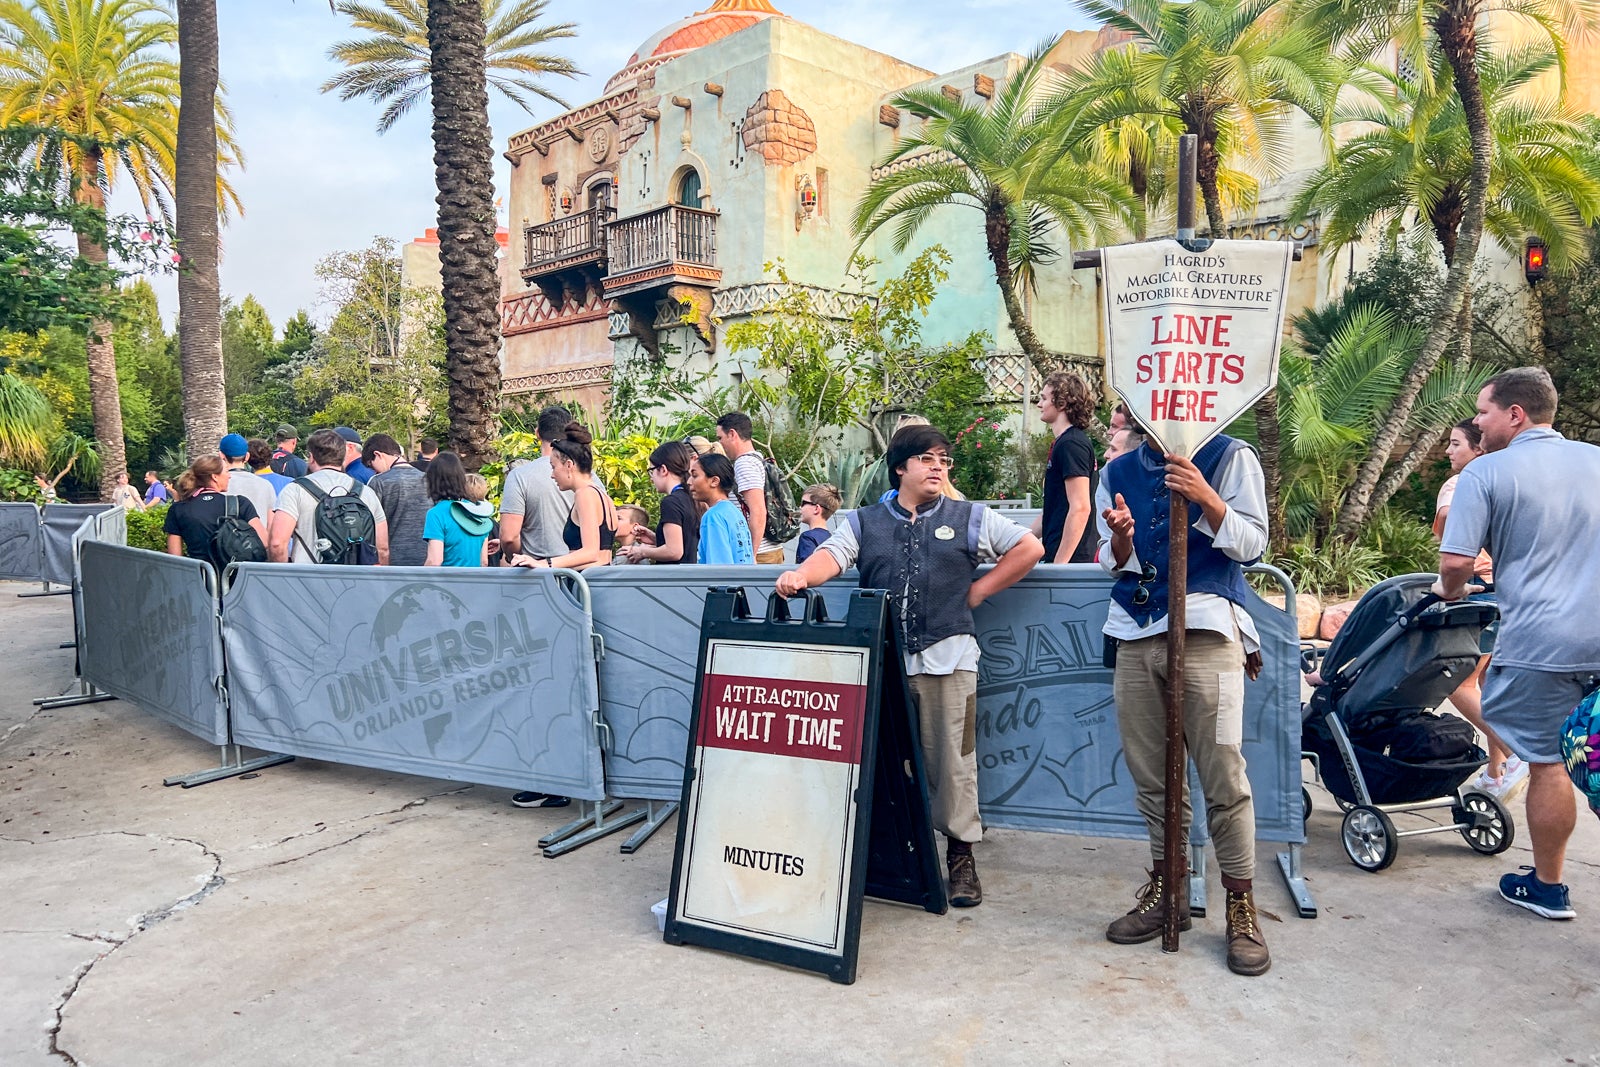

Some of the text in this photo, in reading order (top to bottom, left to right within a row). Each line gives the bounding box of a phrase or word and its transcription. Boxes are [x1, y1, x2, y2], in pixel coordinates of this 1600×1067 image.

[1164, 254, 1226, 268] HAGRID'S
[1127, 270, 1263, 288] MAGICAL CREATURES
[1116, 287, 1189, 305] MOTORBIKE
[1150, 314, 1233, 347] LINE
[1136, 351, 1245, 384] STARTS
[1150, 389, 1218, 423] HERE
[326, 607, 550, 723] UNIVERSAL
[977, 619, 1104, 683] SAL
[353, 662, 532, 741] ORLANDO RESORT
[722, 684, 840, 712] ATTRACTION
[716, 705, 844, 751] WAIT TIME
[977, 745, 1031, 771] ORT
[723, 845, 804, 877] MINUTES
